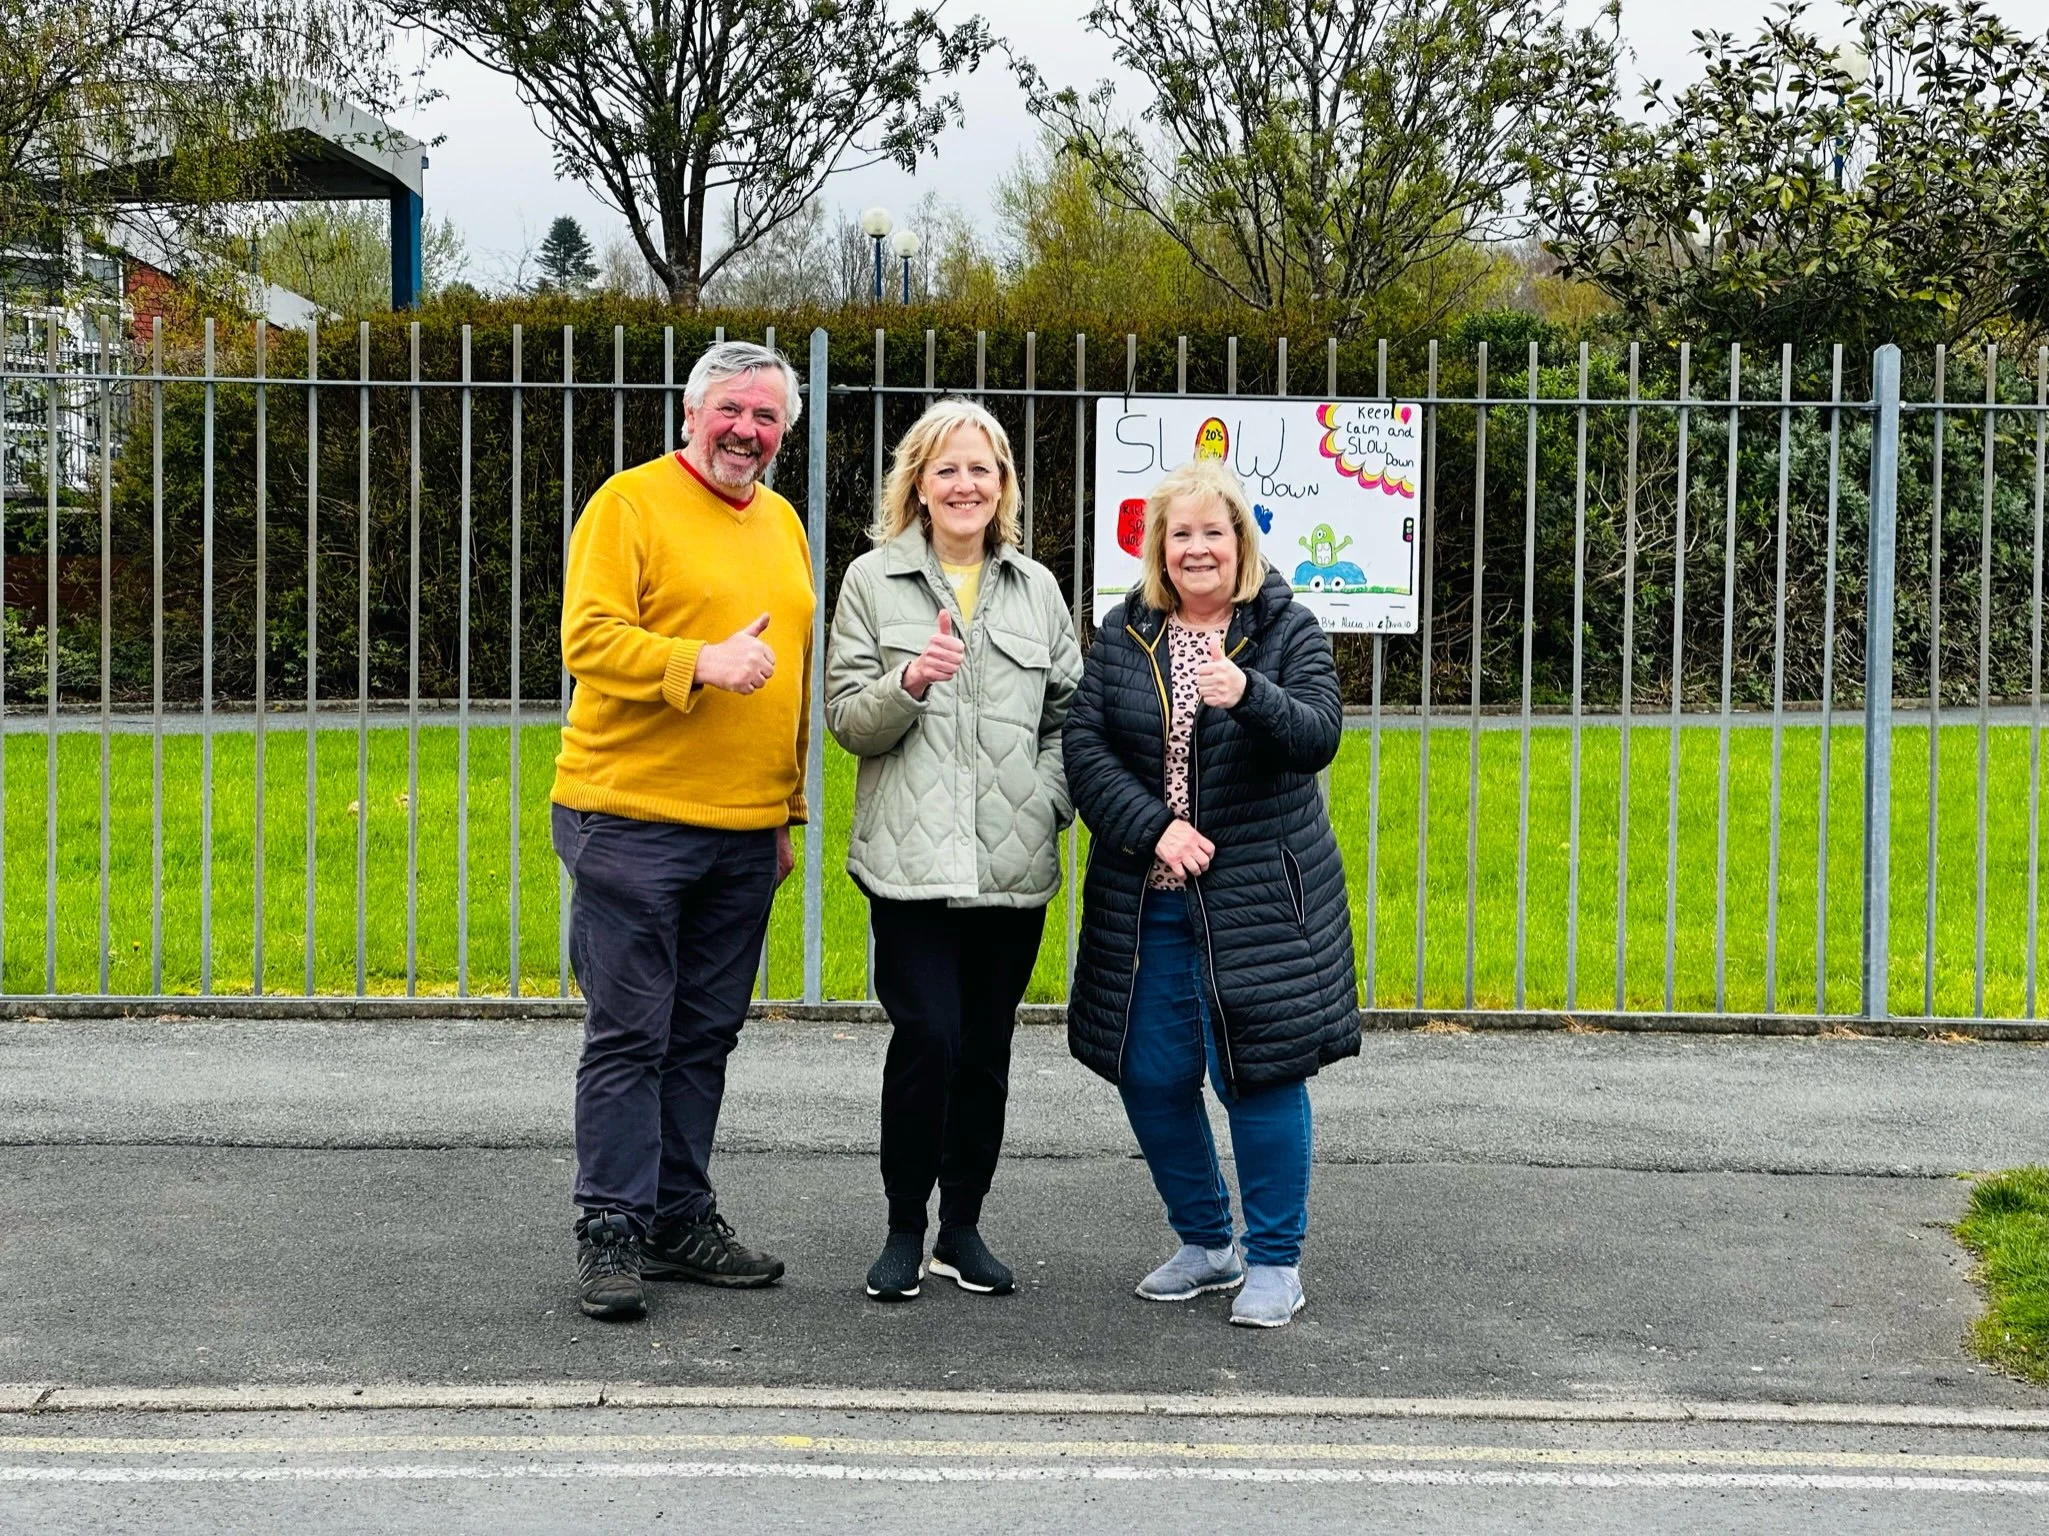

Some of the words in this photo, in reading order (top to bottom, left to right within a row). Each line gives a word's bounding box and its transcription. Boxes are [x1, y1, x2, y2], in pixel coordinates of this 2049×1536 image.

[1387, 426, 1415, 438] and
[1116, 414, 1285, 478] SLOW
[1348, 436, 1388, 455] SLOW
